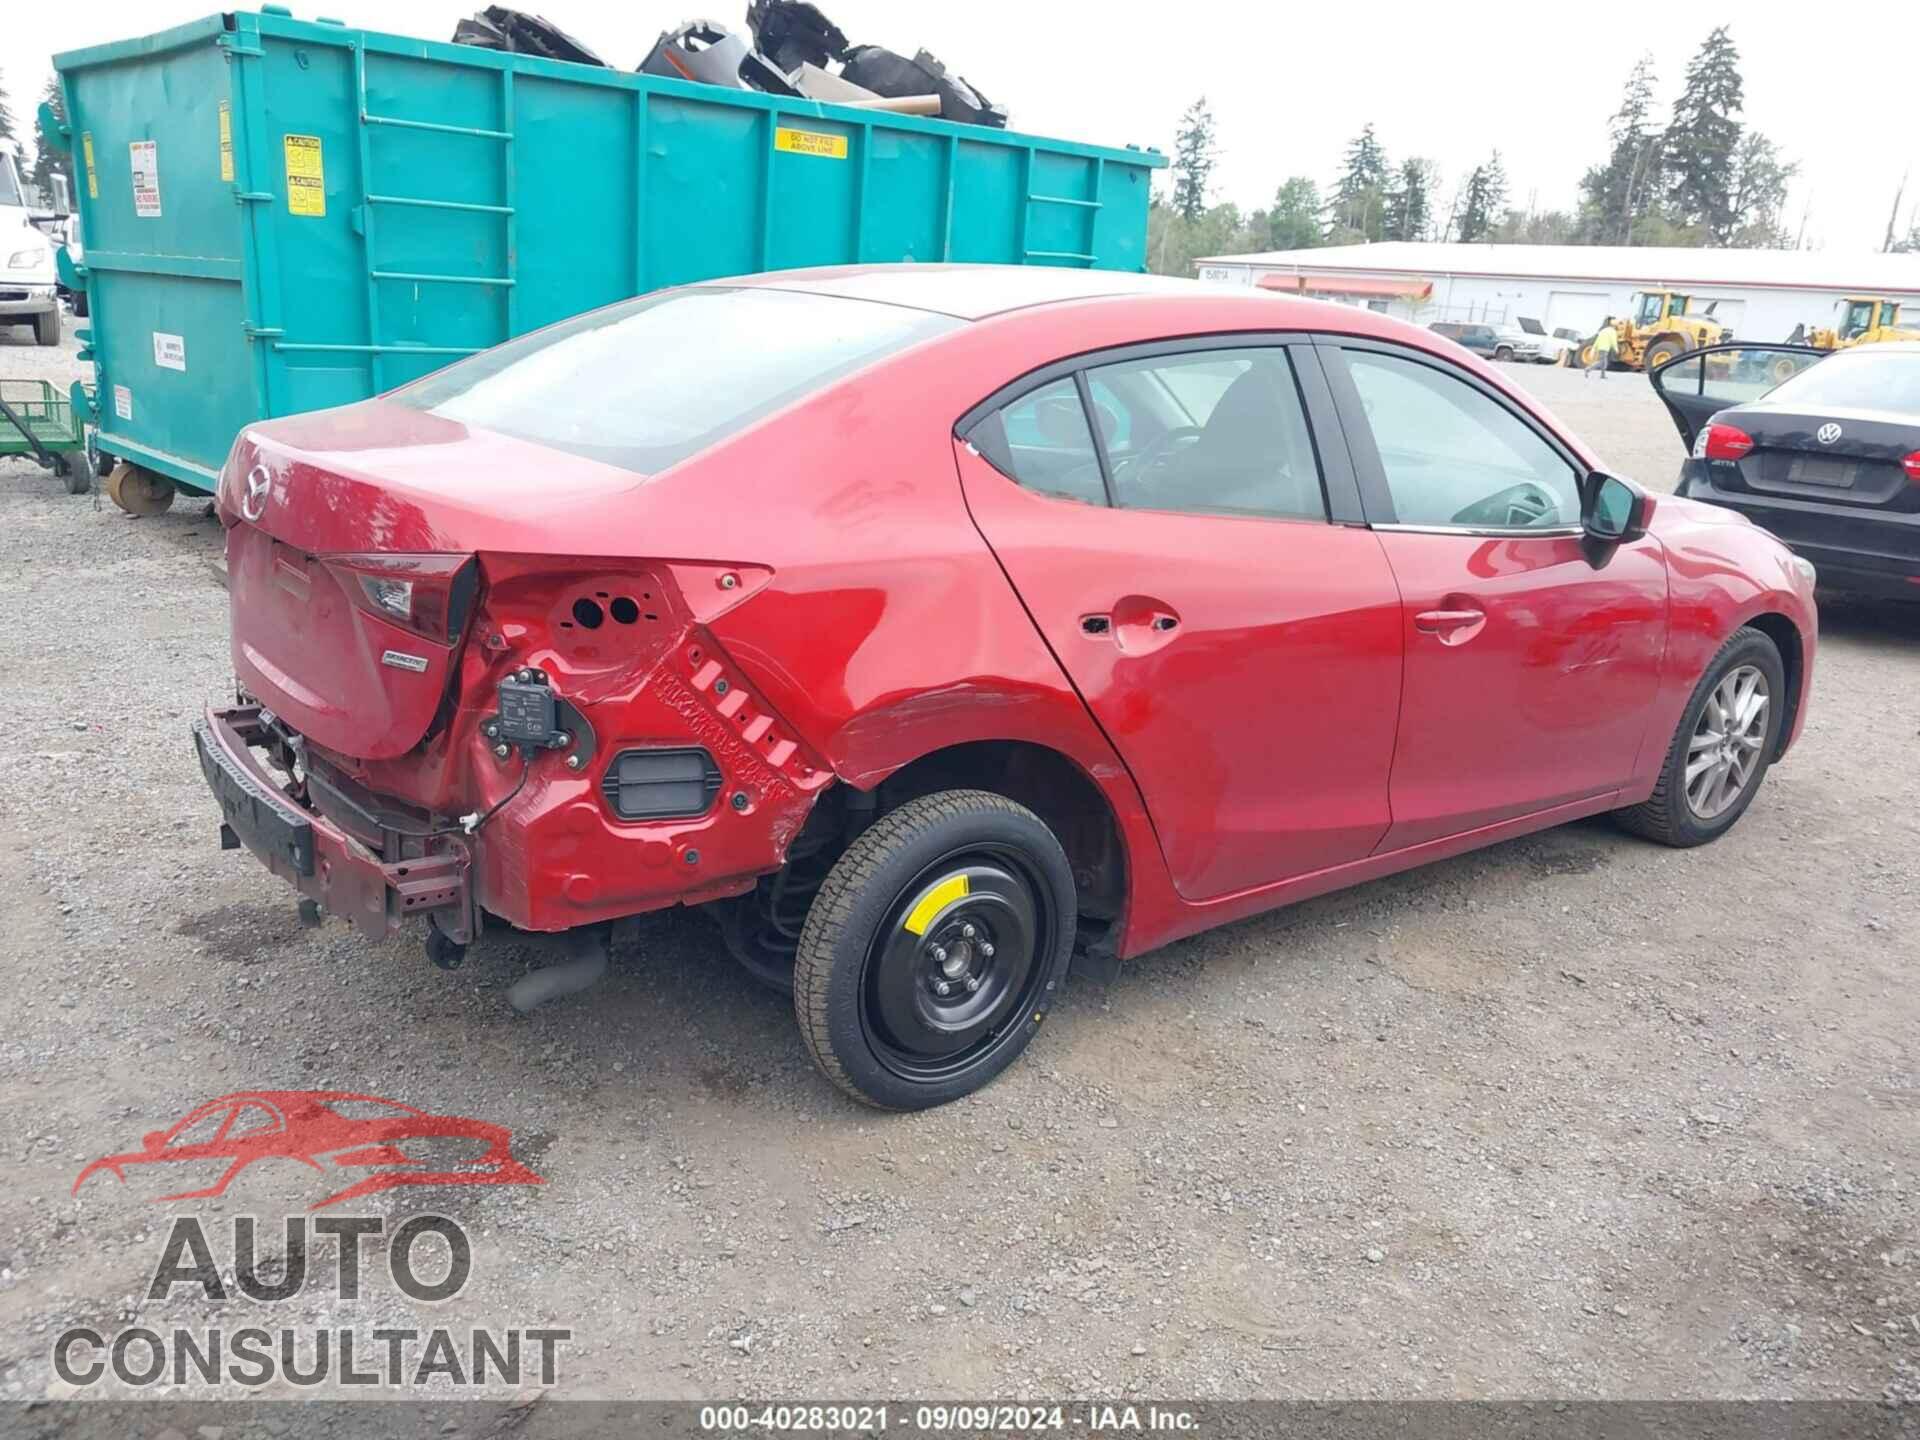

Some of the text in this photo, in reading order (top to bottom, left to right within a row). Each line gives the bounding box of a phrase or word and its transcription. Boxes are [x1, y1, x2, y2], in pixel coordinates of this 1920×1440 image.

[293, 137, 320, 147] CAUTION
[791, 133, 801, 142] DO
[804, 135, 818, 144] NOT
[790, 143, 833, 154] ABOVE LINE
[295, 177, 321, 187] CAUTION
